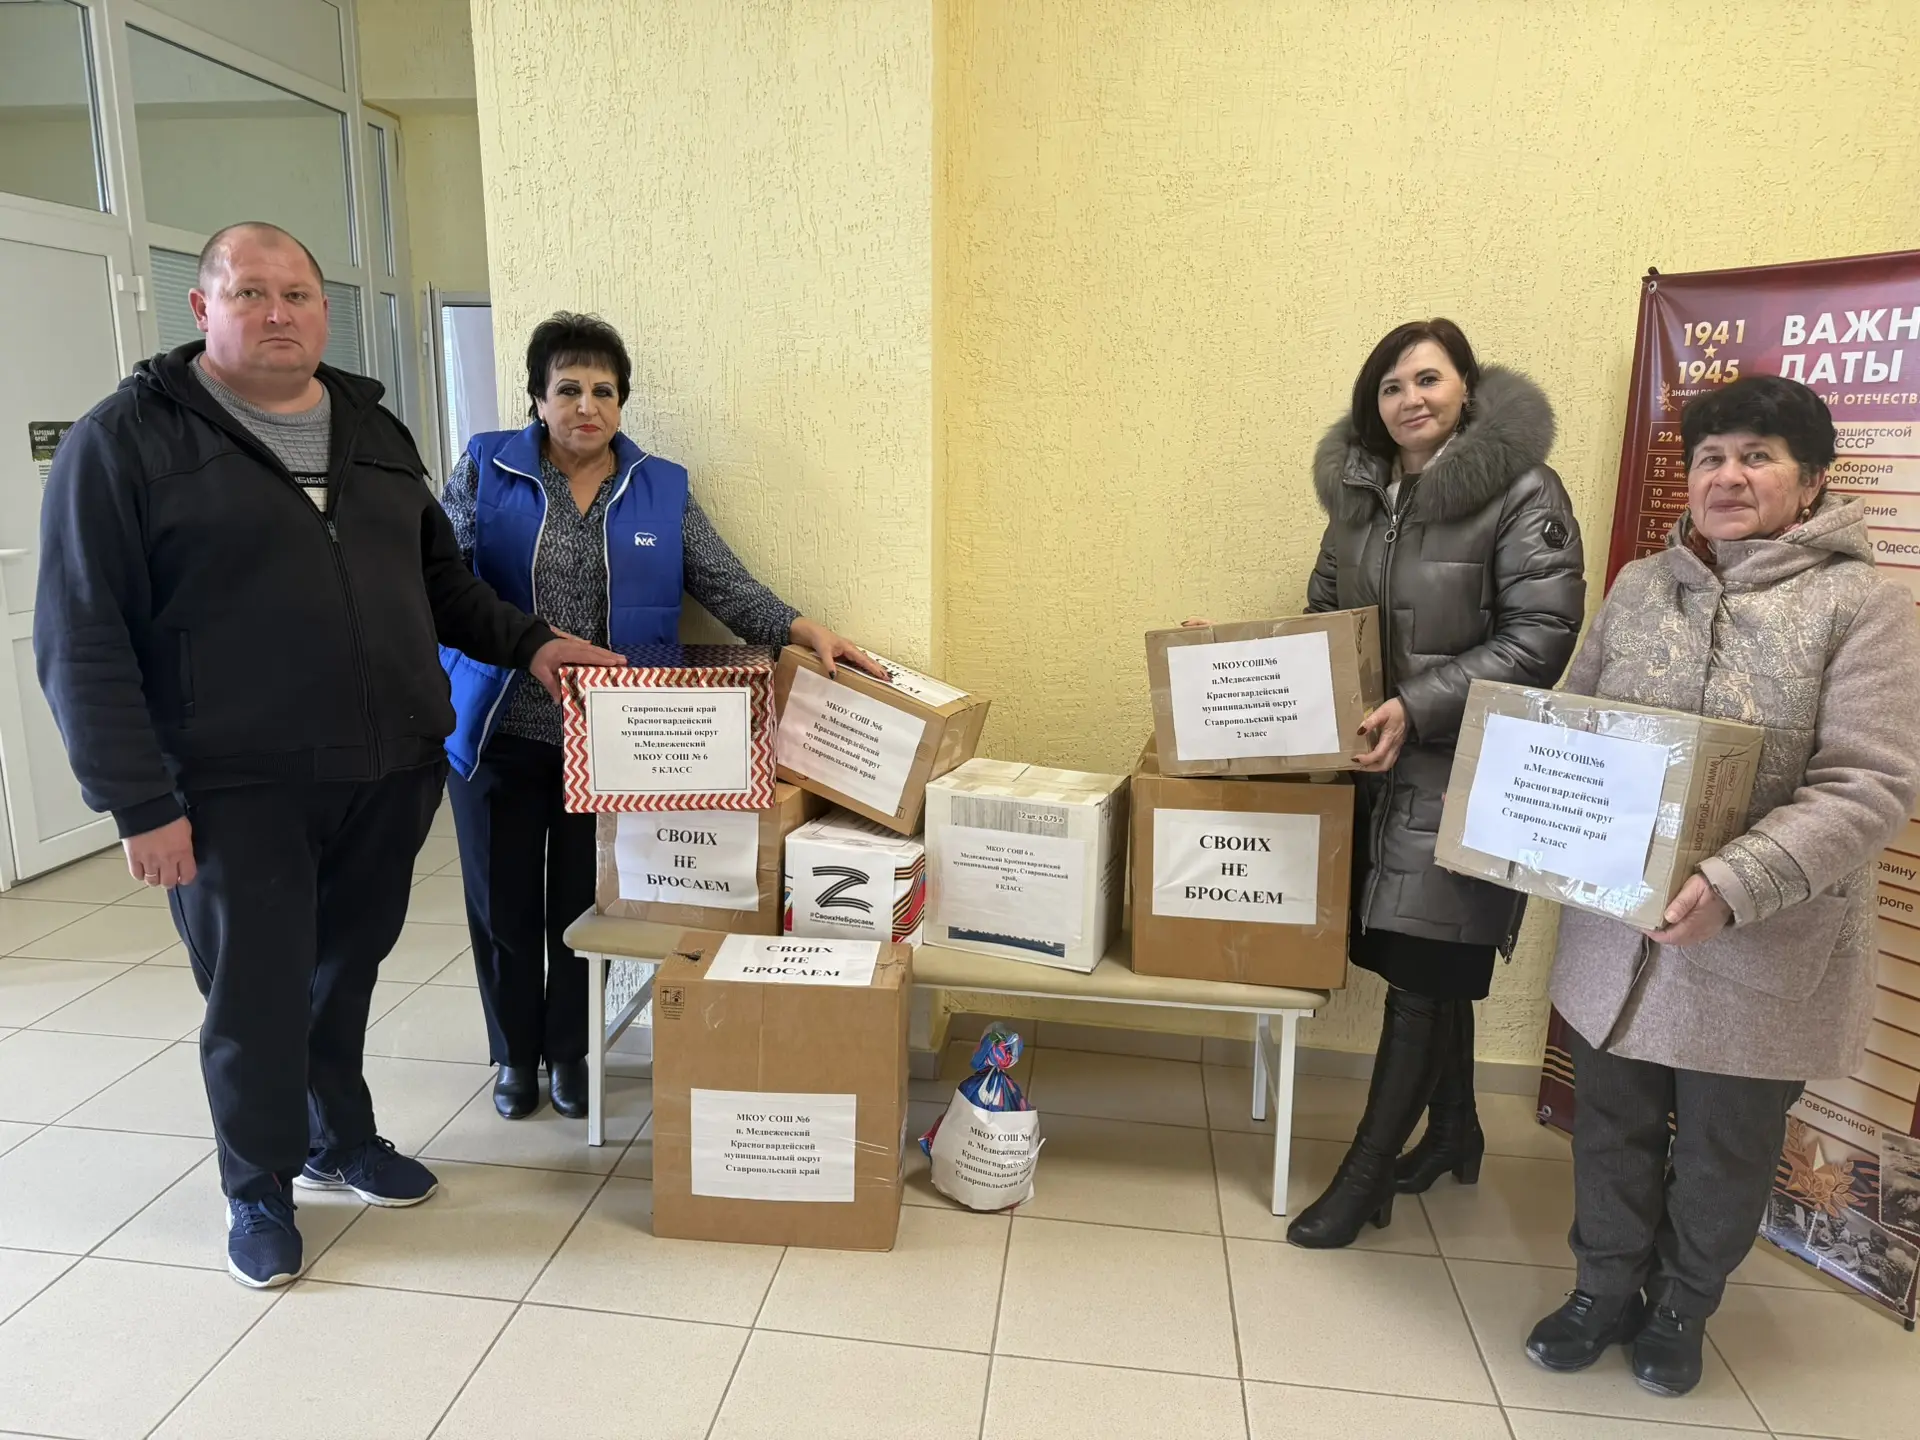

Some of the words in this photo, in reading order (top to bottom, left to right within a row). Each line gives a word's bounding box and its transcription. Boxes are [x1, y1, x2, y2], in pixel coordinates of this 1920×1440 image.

[1684, 319, 1745, 346] 1941
[1782, 306, 1920, 346] ВАЖН
[1678, 359, 1739, 385] 1945
[1779, 350, 1903, 385] ДАТЫ
[1844, 393, 1920, 405] ОТЕЧЕСТВ
[1658, 431, 1673, 442] 22
[1834, 426, 1912, 437] ашистской
[1835, 438, 1874, 448] СССР
[1655, 457, 1667, 465] 22
[1653, 469, 1665, 478] 23
[1834, 462, 1893, 475] оборона
[1652, 488, 1663, 496] 10
[1650, 500, 1660, 508] 10
[1864, 506, 1897, 516] ение
[1650, 519, 1655, 527] 5
[1646, 531, 1656, 539] 16
[1877, 540, 1920, 554] Одесс
[1212, 657, 1278, 670] МКОУСОШ№6
[1212, 672, 1281, 686] п.Медвеженский
[1206, 686, 1290, 701] Красногвардейский
[621, 705, 695, 714] Ставропольский
[697, 705, 717, 714] край
[1201, 700, 1271, 713] муниципальный
[1272, 699, 1297, 709] округ
[627, 716, 712, 726] Красногвардейский
[824, 700, 850, 717] МКОУ
[850, 712, 871, 726] СОШ
[870, 721, 883, 731] №6
[1204, 714, 1274, 728] Ставропольский
[1276, 713, 1298, 724] край
[621, 728, 692, 737] муниципальный
[694, 729, 719, 737] округ
[829, 716, 879, 743] Медвеженский
[1243, 730, 1268, 738] класс
[634, 740, 706, 748] п.Медвеженский
[813, 722, 880, 757] Красногвардейский
[633, 753, 663, 761] МКОУ
[665, 753, 689, 761] СОШ
[691, 753, 702, 761] №
[703, 753, 708, 761] 6
[805, 731, 860, 760] муниципальный
[861, 756, 882, 769] округ
[1528, 744, 1605, 769] МКОУСОШ№6
[802, 742, 858, 773] Ставропольский
[858, 769, 876, 781] край
[652, 766, 657, 774] 5
[659, 766, 693, 774] КЛАСС
[1523, 762, 1605, 788] п.Медвеженский
[1513, 776, 1610, 807] Красногвардейский
[1504, 790, 1584, 818] муниципальный
[1585, 809, 1614, 825] округ
[1501, 807, 1582, 836] Ставропольский
[1582, 827, 1608, 842] край
[656, 828, 718, 846] СВОИХ
[1199, 834, 1271, 853] СВОИХ
[1532, 832, 1538, 841] 2
[1540, 836, 1568, 850] класс
[986, 845, 1005, 853] МКОУ
[1007, 847, 1024, 855] СОШ
[674, 855, 697, 869] НЕ
[953, 860, 999, 871] муниципальный
[1020, 869, 1069, 880] Ставропольский
[1221, 862, 1248, 878] НЕ
[646, 874, 730, 892] БРОСАЕМ
[1000, 884, 1024, 892] КЛАСС
[1184, 886, 1283, 905] БРОСАЕМ
[1877, 895, 1914, 912] ропе
[766, 945, 833, 954] СВОИХ
[782, 956, 809, 964] НЕ
[742, 966, 841, 977] БРОСАЕМ
[736, 1113, 767, 1122] МКОУ
[768, 1115, 793, 1123] СОШ
[795, 1116, 811, 1124] №6
[746, 1127, 810, 1137] Медвеженский
[969, 1126, 996, 1141] МКОУ
[998, 1134, 1019, 1142] СОШ
[730, 1140, 816, 1151] Красногвардейский
[724, 1152, 795, 1162] муниципальный
[797, 1155, 822, 1163] округ
[725, 1164, 797, 1175] Ставропольский
[799, 1168, 820, 1176] край
[955, 1159, 1018, 1178] муниципальный
[955, 1170, 1018, 1189] Ставропольский
